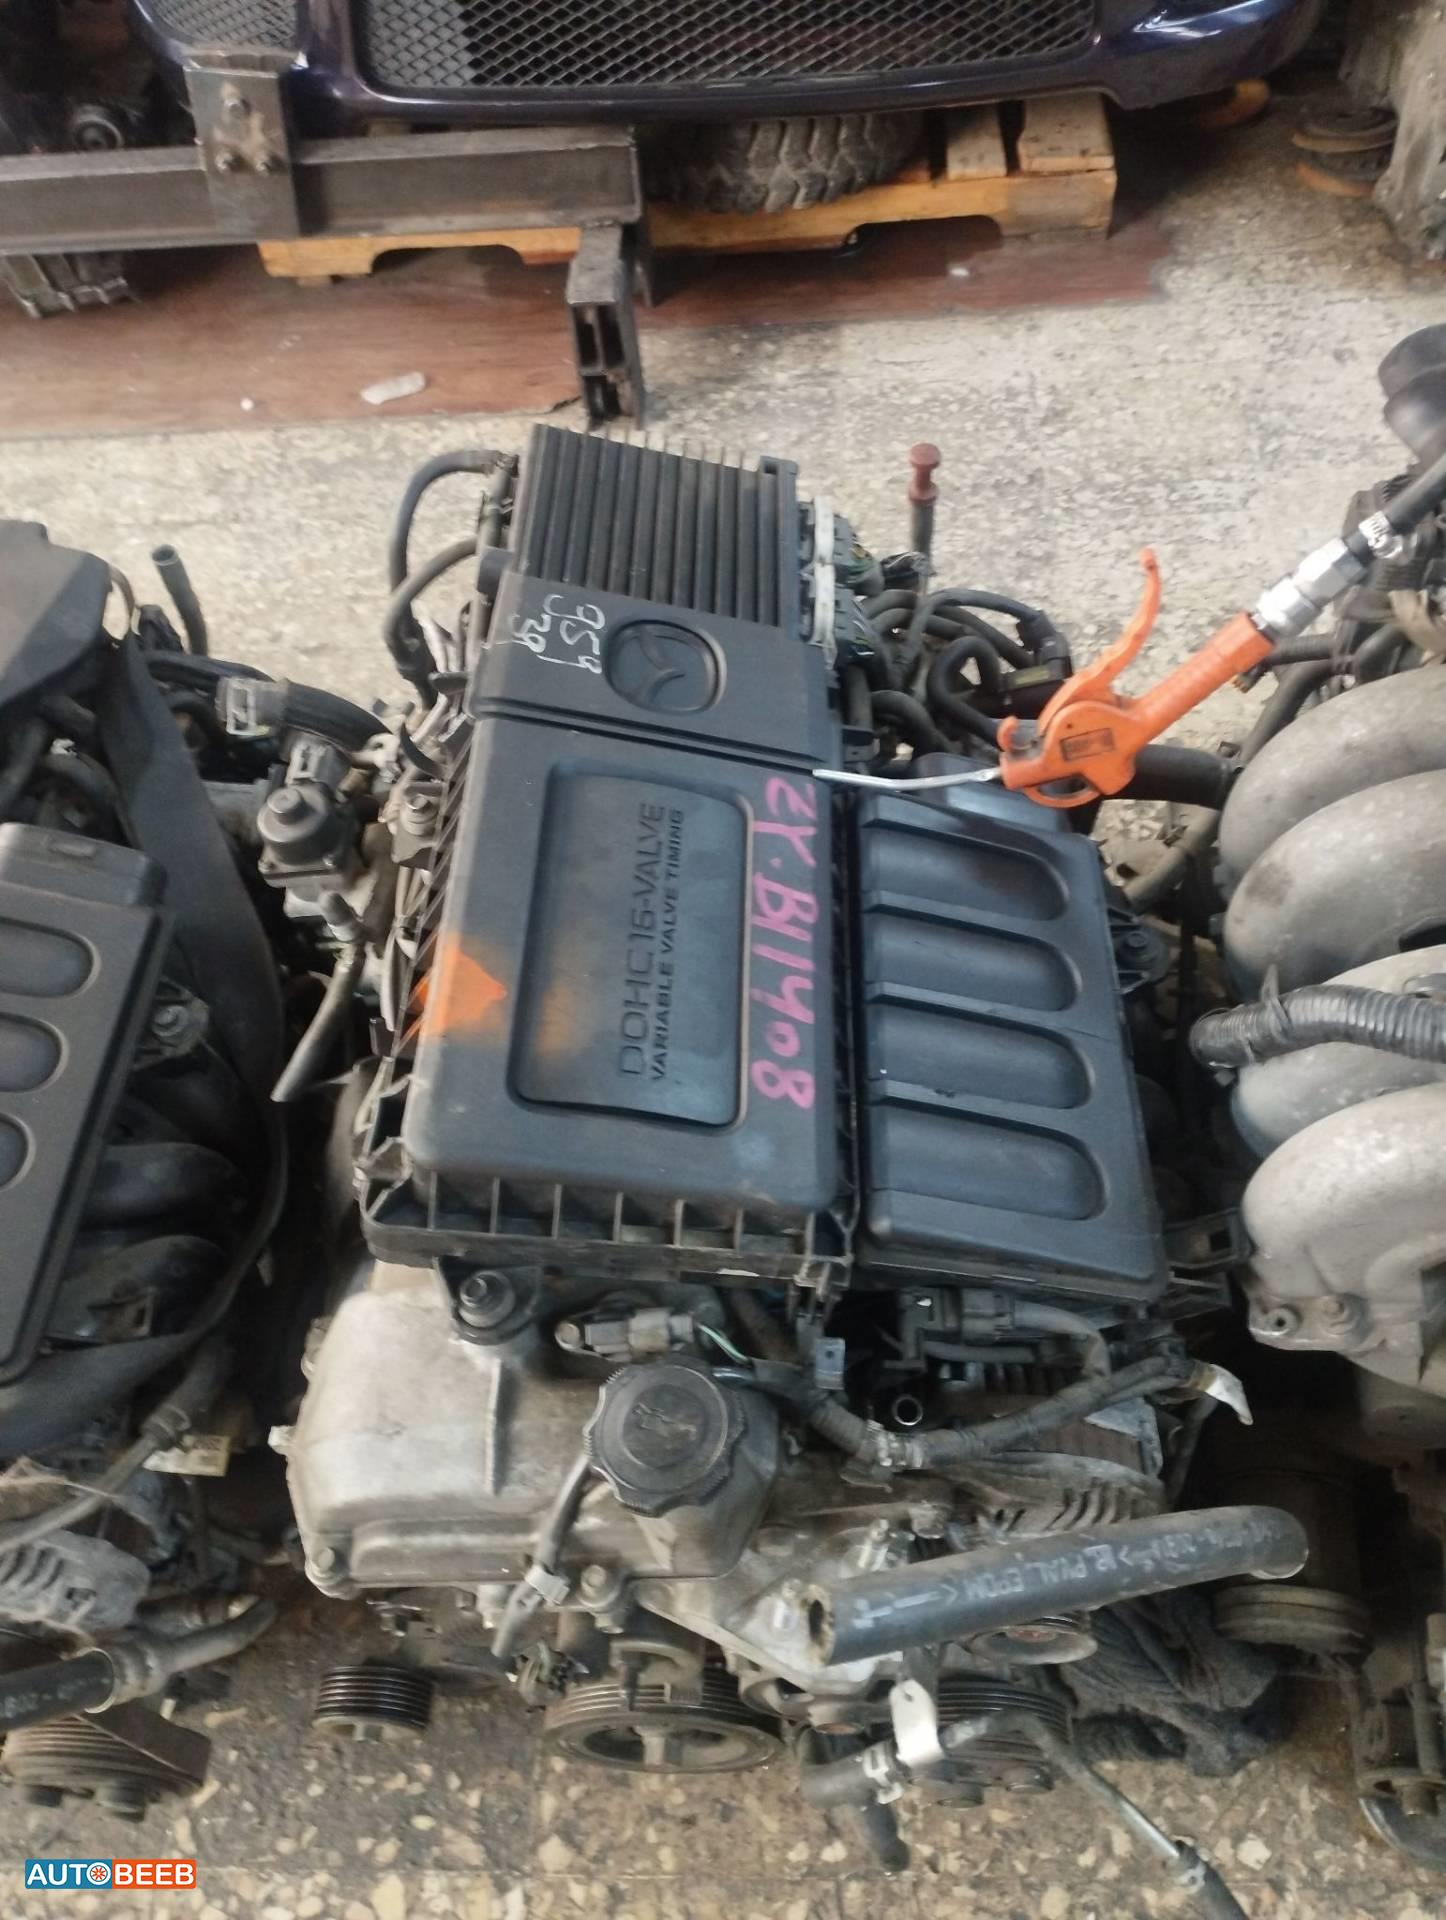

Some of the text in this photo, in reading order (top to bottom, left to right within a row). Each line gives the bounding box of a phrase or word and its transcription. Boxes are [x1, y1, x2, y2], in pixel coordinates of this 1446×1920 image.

[616, 802, 666, 1078] DOHC 16-VALVE
[651, 808, 684, 1080] VARIABLE VALVE TIMING
